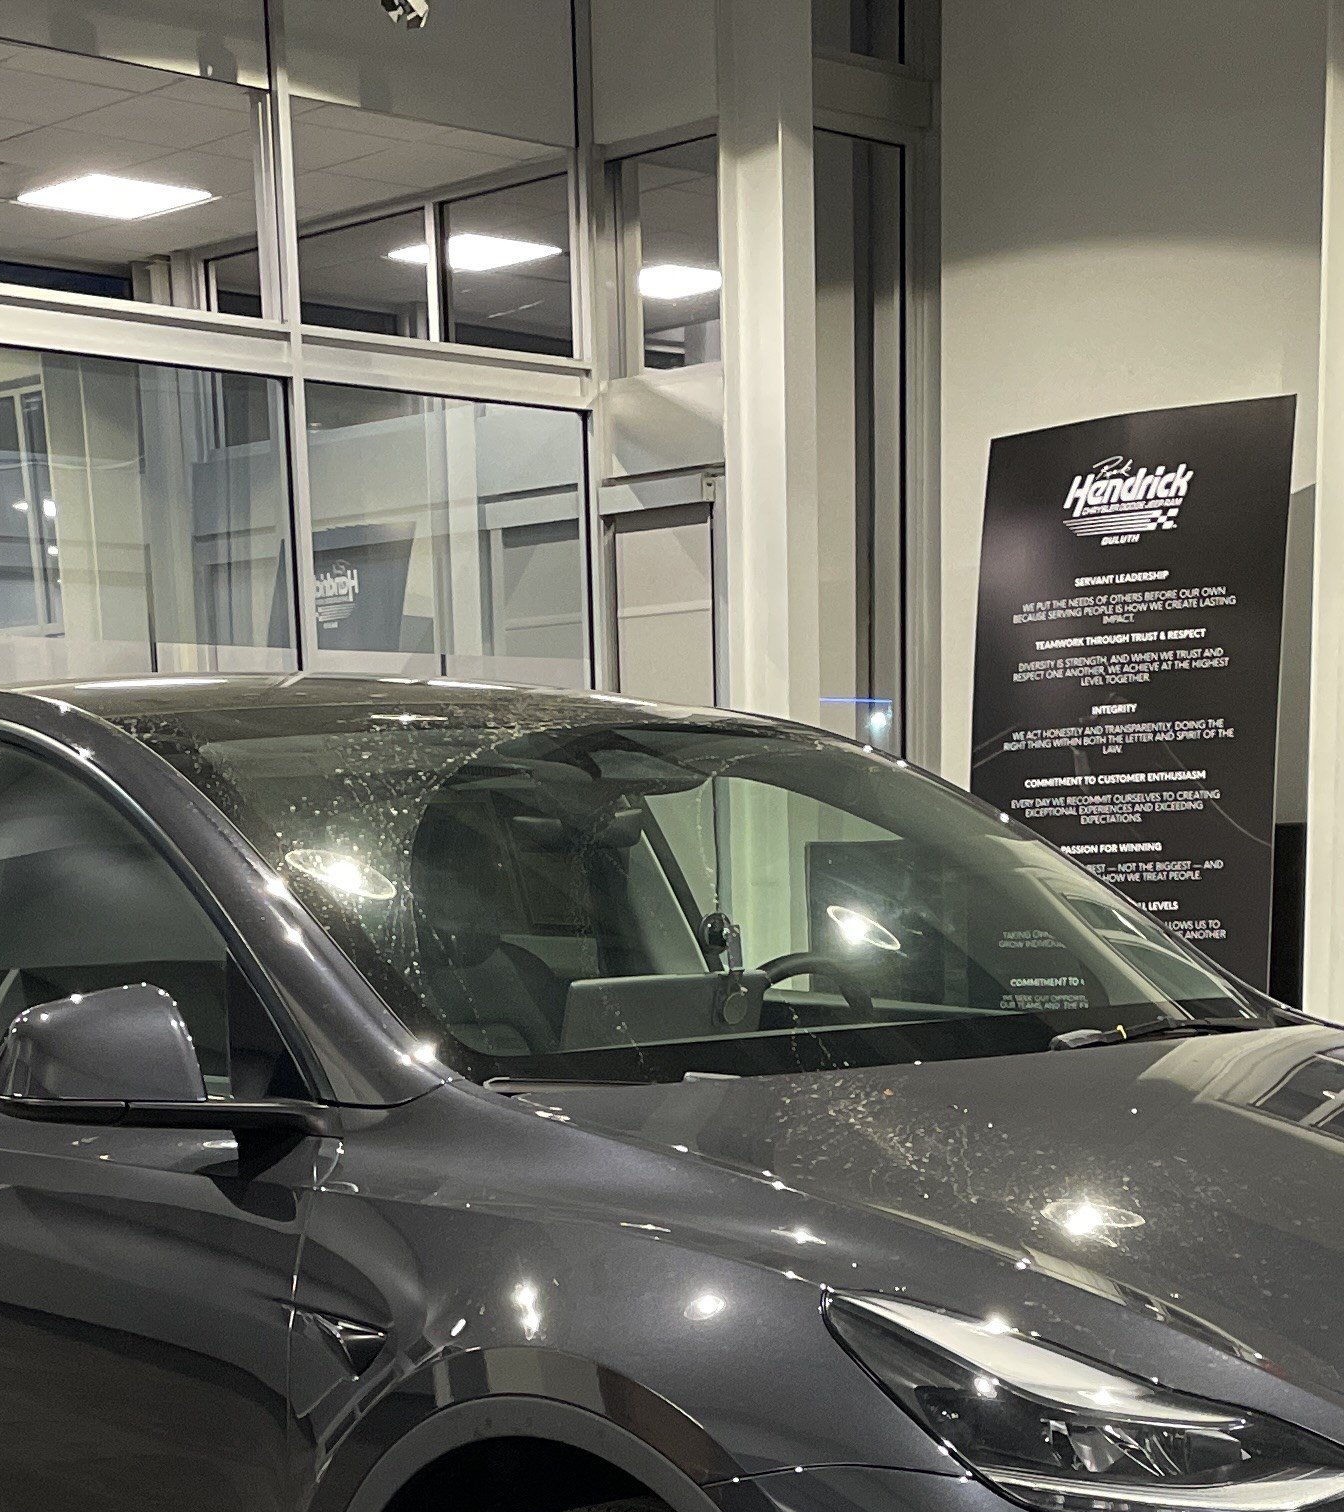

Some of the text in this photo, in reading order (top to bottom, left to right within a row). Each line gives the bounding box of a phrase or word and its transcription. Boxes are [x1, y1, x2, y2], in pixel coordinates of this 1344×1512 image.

[1063, 463, 1194, 518] Hendrick
[1101, 533, 1140, 546] DULUTH
[1074, 570, 1170, 588] SERVANT LEADERSHIP
[1022, 586, 1227, 613] WE PUT THE NEEDS OF OTHERS BEFORE OUR OWN
[1013, 595, 1236, 624] BECAUSE SERVING PEOPLE IS HOW WE CREATE LASTING
[1036, 628, 1206, 650] TEAMWORK THROUGH TRUST & RESPECT
[1018, 660, 1056, 672] DIVERSITY
[1056, 658, 1064, 668] IS
[1110, 653, 1130, 664] AND
[1130, 651, 1158, 662] WHEN
[1160, 650, 1174, 660] WE
[1176, 648, 1202, 660] TRUST
[1203, 647, 1224, 658] AND
[1013, 670, 1044, 682] RESPECT
[1046, 668, 1064, 680] ONE
[1108, 664, 1122, 674] WE
[1122, 662, 1160, 673] ACHIEVE
[1161, 661, 1173, 671] AT
[1174, 660, 1190, 670] THE
[1192, 657, 1230, 668] HIGHEST
[1080, 676, 1104, 686] LEVEL
[1092, 703, 1137, 715] INTEGRITY
[1012, 731, 1026, 741] WE
[1026, 730, 1042, 740] ACT
[1042, 727, 1084, 738] HONESTLY
[1084, 726, 1104, 736] AND
[1174, 720, 1206, 731] DOING
[1208, 718, 1225, 729] THE
[1003, 728, 1235, 752] RIGHT THING WITHIN BOTH THE LETTER AND SPIRIT OF THE
[1024, 770, 1206, 788] COMMITMENT TO CUSTOMER ENTHUSIASM
[1010, 789, 1221, 809] EVERY DAY WE RECOMMIT OURSELVES TO CREATING
[1025, 800, 1204, 818] EXCEPTIONAL EXPERIENCES AND EXCEEDING
[1061, 842, 1162, 855] PASSION FOR WINNING
[1118, 862, 1136, 872] NOT
[1138, 862, 1154, 872] THE
[1156, 860, 1192, 872] BIGGEST
[1204, 860, 1224, 869] AND
[1102, 872, 1126, 882] HOW
[1126, 872, 1141, 882] WE
[1142, 872, 1168, 882] TREAT
[1148, 901, 1178, 911] LEVELS
[1195, 920, 1207, 930] US
[1208, 919, 1221, 929] TO
[1184, 929, 1226, 940] ANOTHER
[1010, 976, 1068, 987] COMMITMENT
[1068, 976, 1080, 986] TO
